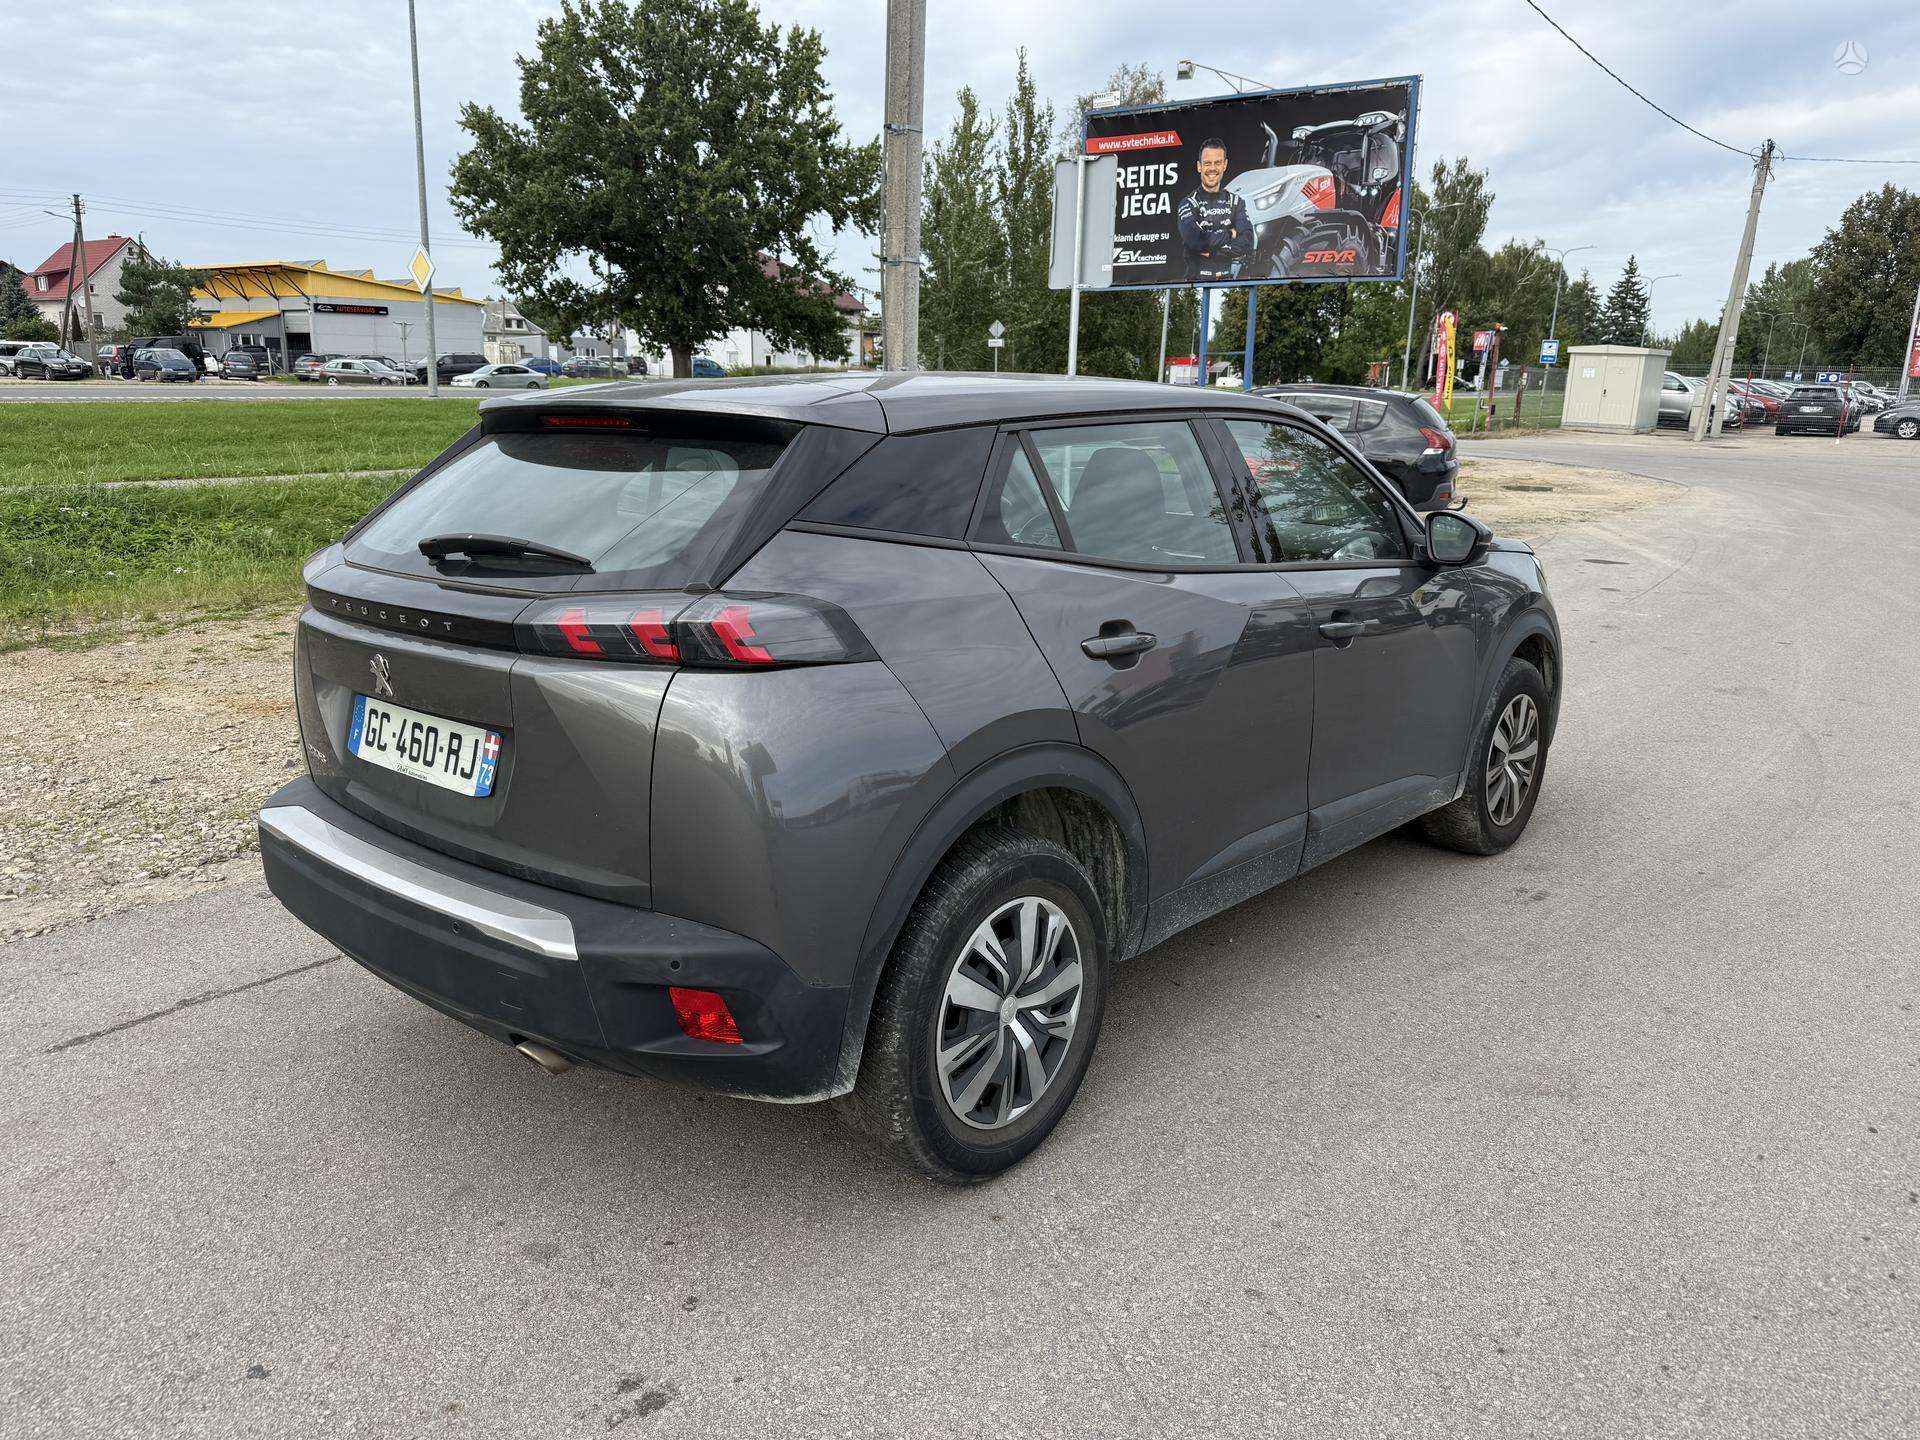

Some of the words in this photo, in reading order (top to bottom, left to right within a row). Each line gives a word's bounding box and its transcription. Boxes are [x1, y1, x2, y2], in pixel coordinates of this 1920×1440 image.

[1098, 133, 1175, 150] www.svtechnika.lt
[1121, 188, 1171, 219] JĖGA
[1134, 232, 1160, 243] drauge
[1160, 232, 1170, 240] su
[1302, 250, 1356, 263] STEYR
[335, 305, 376, 314] AUTOSERVISAS
[331, 598, 452, 631] PEUGEOT
[479, 763, 494, 785] 73
